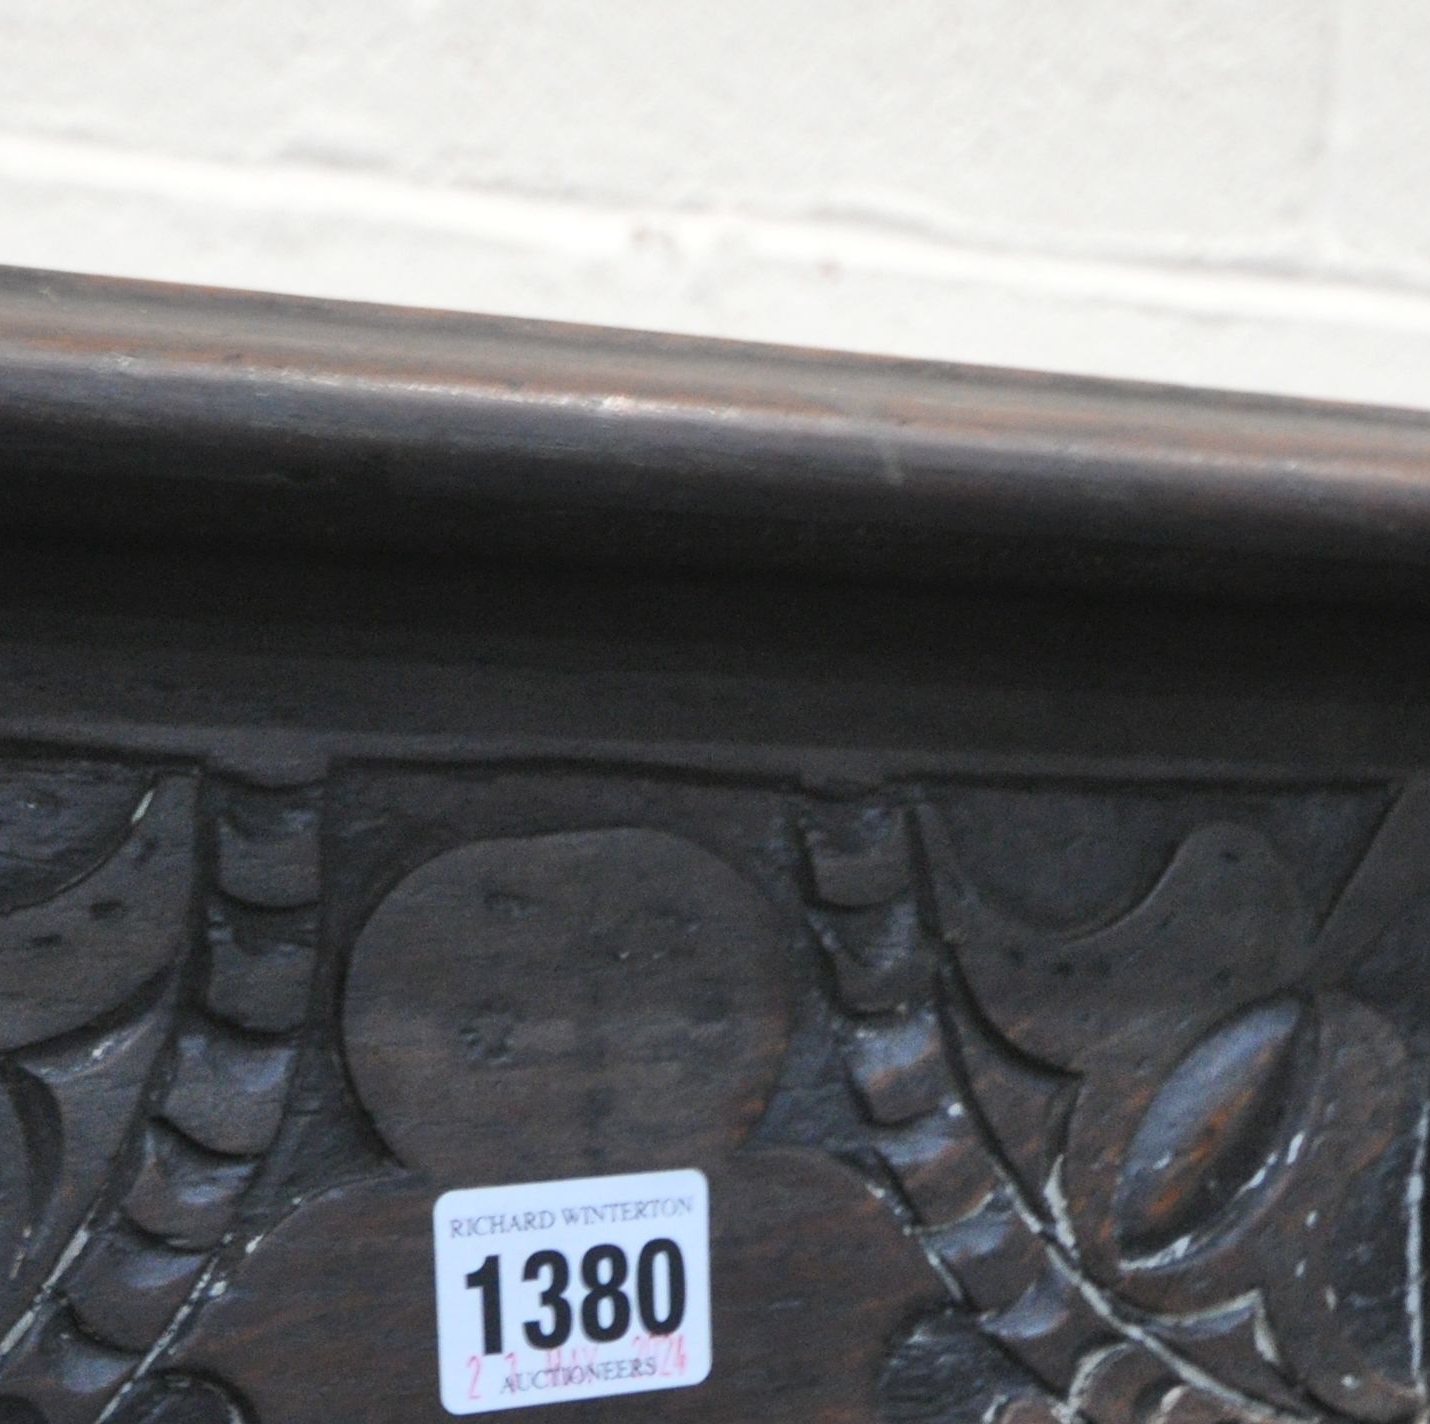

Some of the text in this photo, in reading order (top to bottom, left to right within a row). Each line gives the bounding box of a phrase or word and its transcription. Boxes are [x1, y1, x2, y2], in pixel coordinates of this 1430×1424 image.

[449, 1196, 694, 1238] RICHARD WINTERTON
[465, 1237, 686, 1356] 1380
[500, 1357, 658, 1395] AUCTIONEERS
